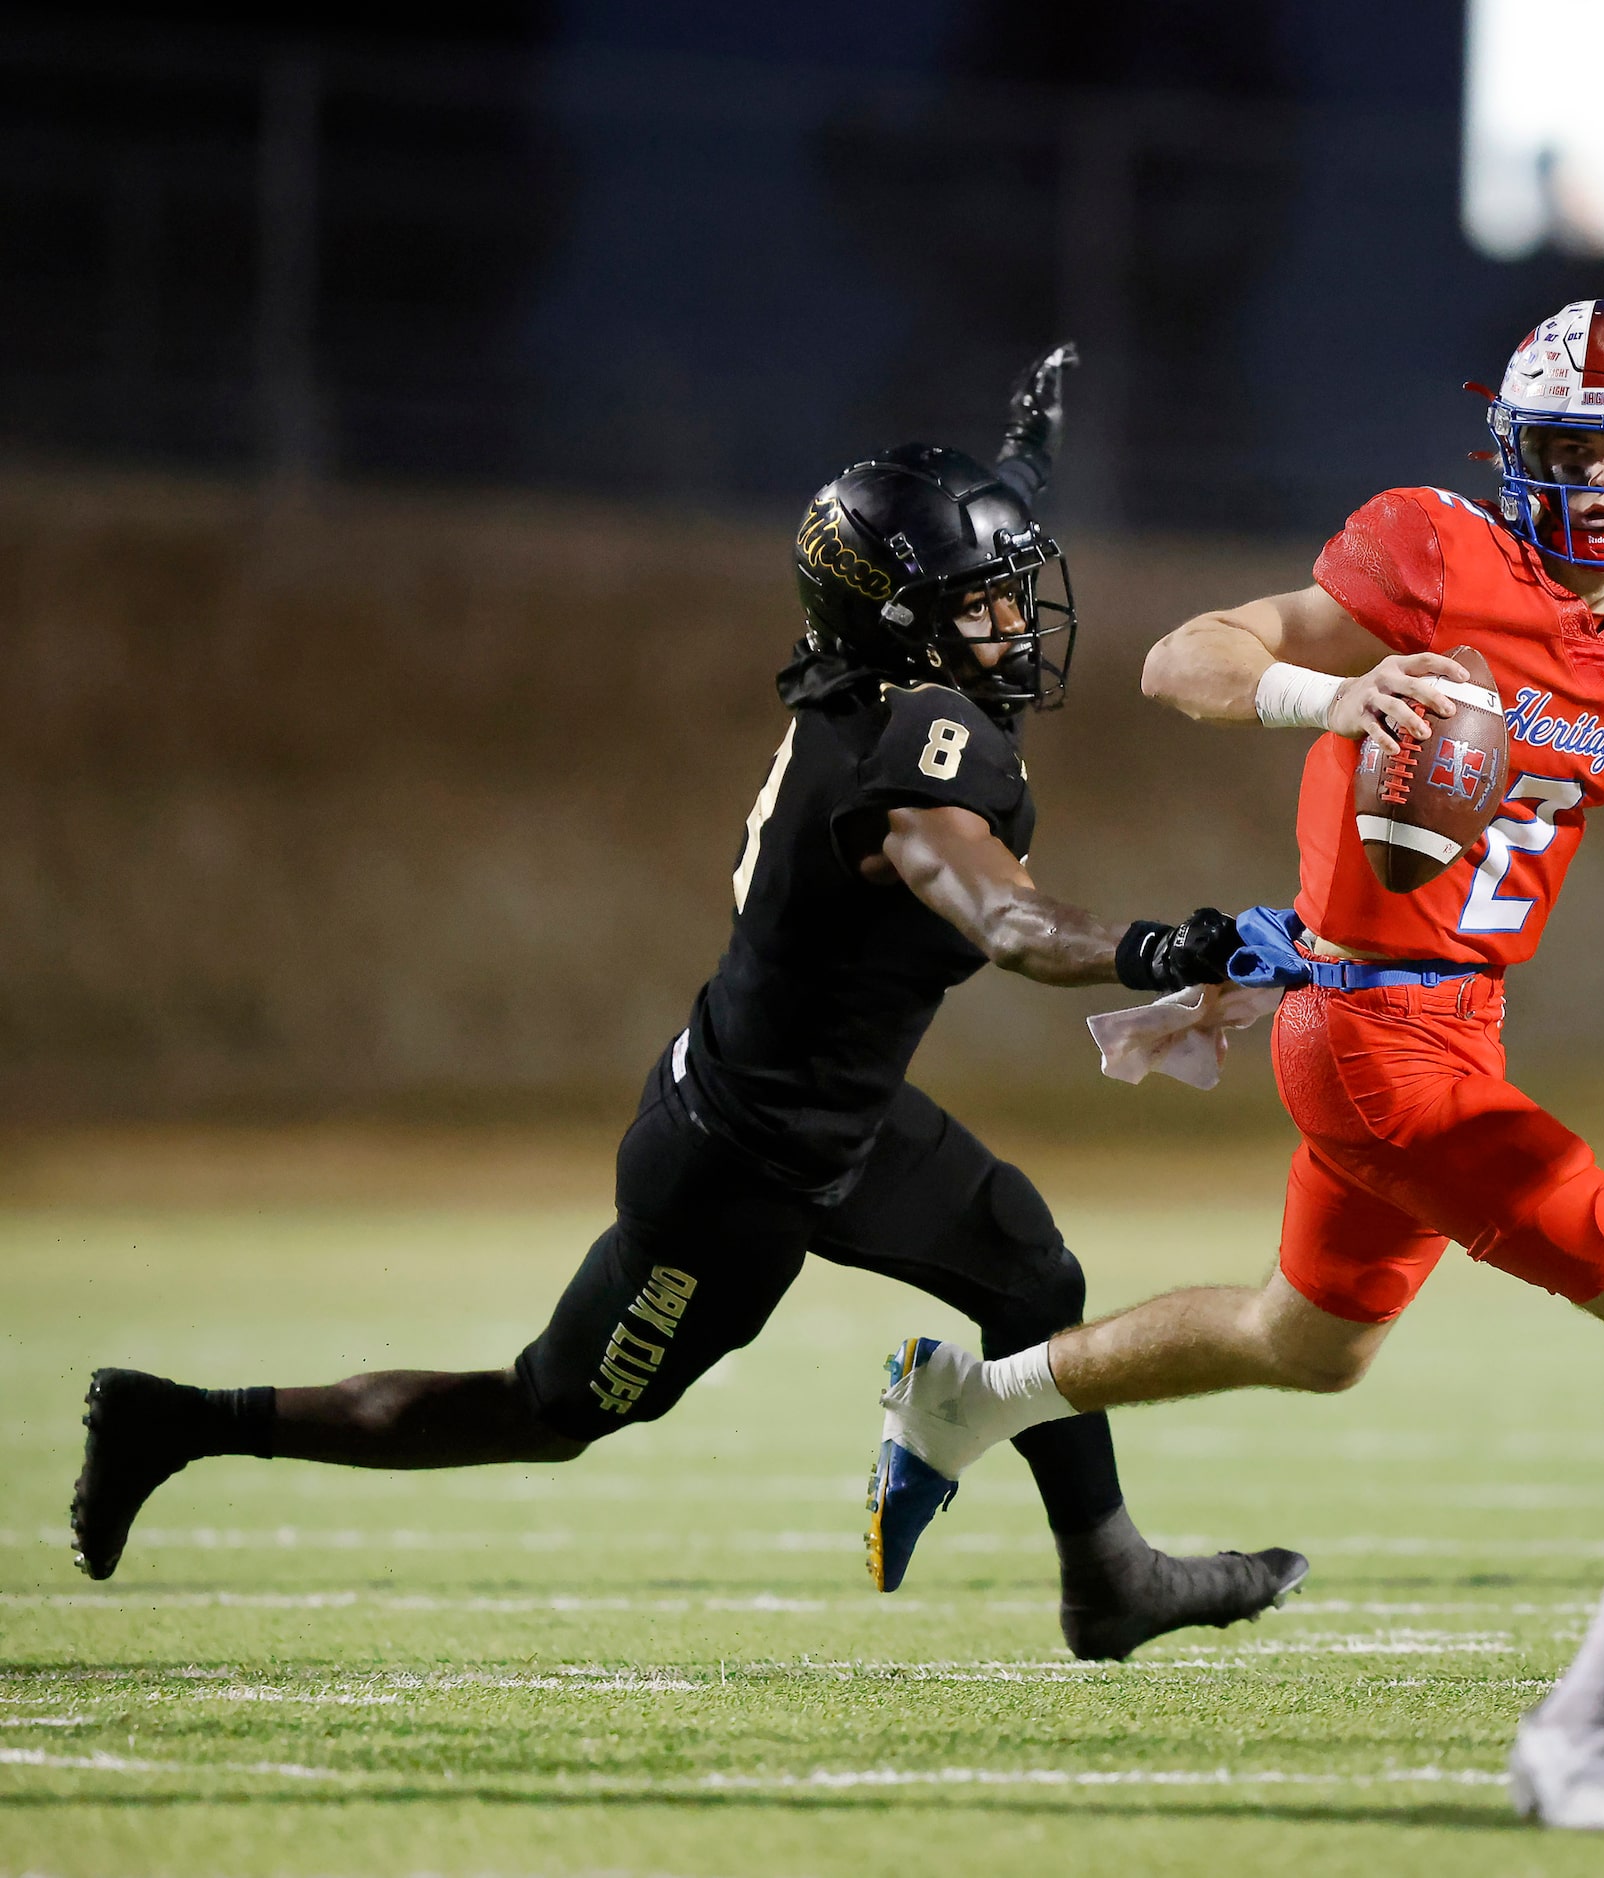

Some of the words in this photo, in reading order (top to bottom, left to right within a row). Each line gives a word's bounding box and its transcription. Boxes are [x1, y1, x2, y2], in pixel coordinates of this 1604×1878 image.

[918, 718, 970, 781] 8
[1456, 771, 1585, 934] 2
[627, 1264, 698, 1339] OAK
[589, 1320, 666, 1415] CLIFF
